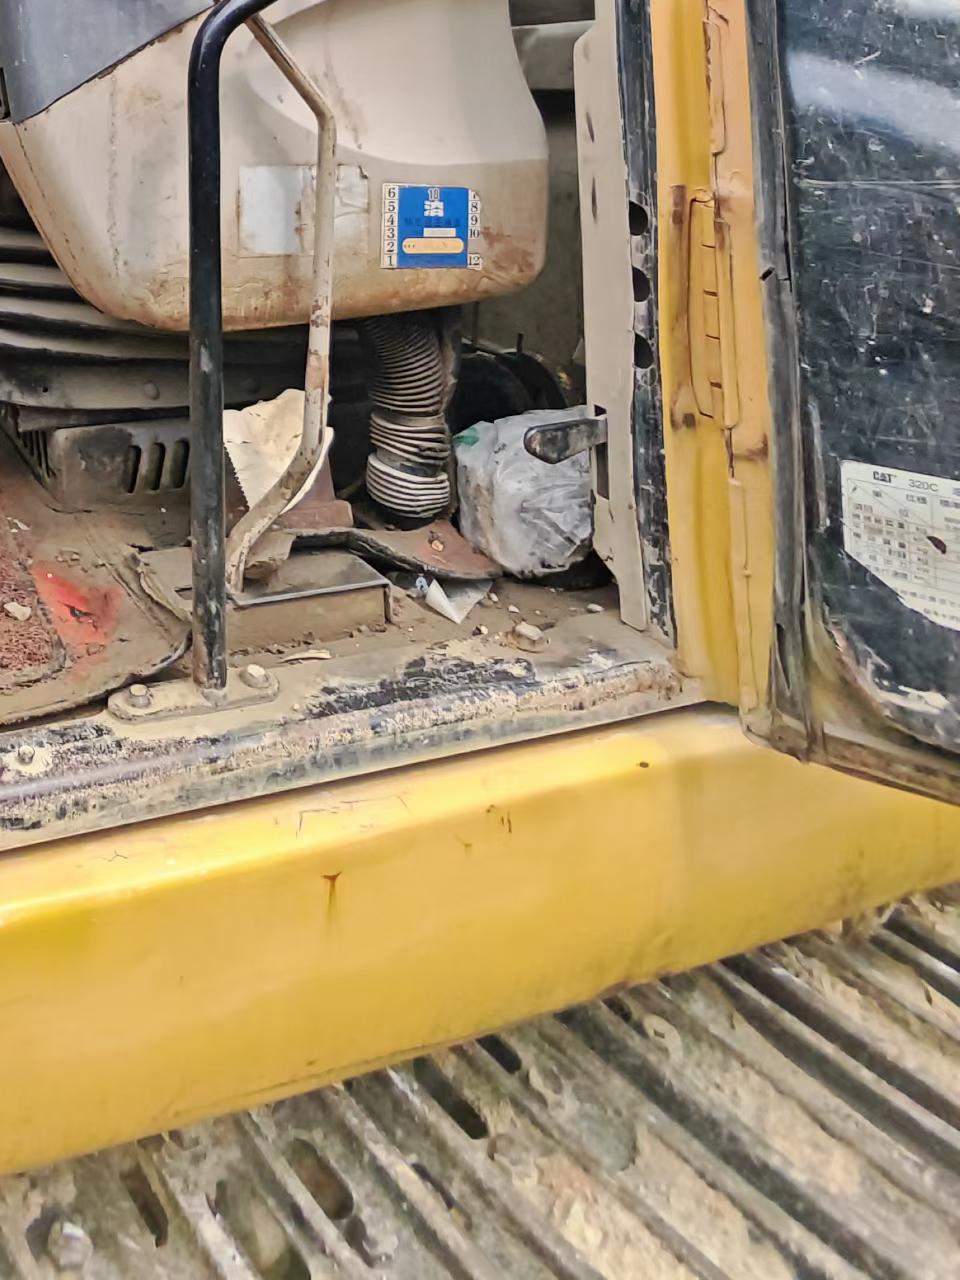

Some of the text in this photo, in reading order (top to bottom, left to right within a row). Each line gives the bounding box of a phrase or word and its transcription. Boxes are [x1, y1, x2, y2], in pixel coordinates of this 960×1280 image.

[388, 187, 396, 199] 6
[387, 201, 396, 212] 5
[470, 201, 479, 213] 8
[387, 214, 395, 226] 4
[470, 215, 478, 226] 9
[386, 227, 395, 239] 3
[469, 228, 481, 239] 10
[386, 241, 395, 253] 2
[387, 255, 393, 266] 1
[468, 255, 481, 266] 12
[873, 471, 893, 483] CAT
[908, 478, 939, 492] 320C
